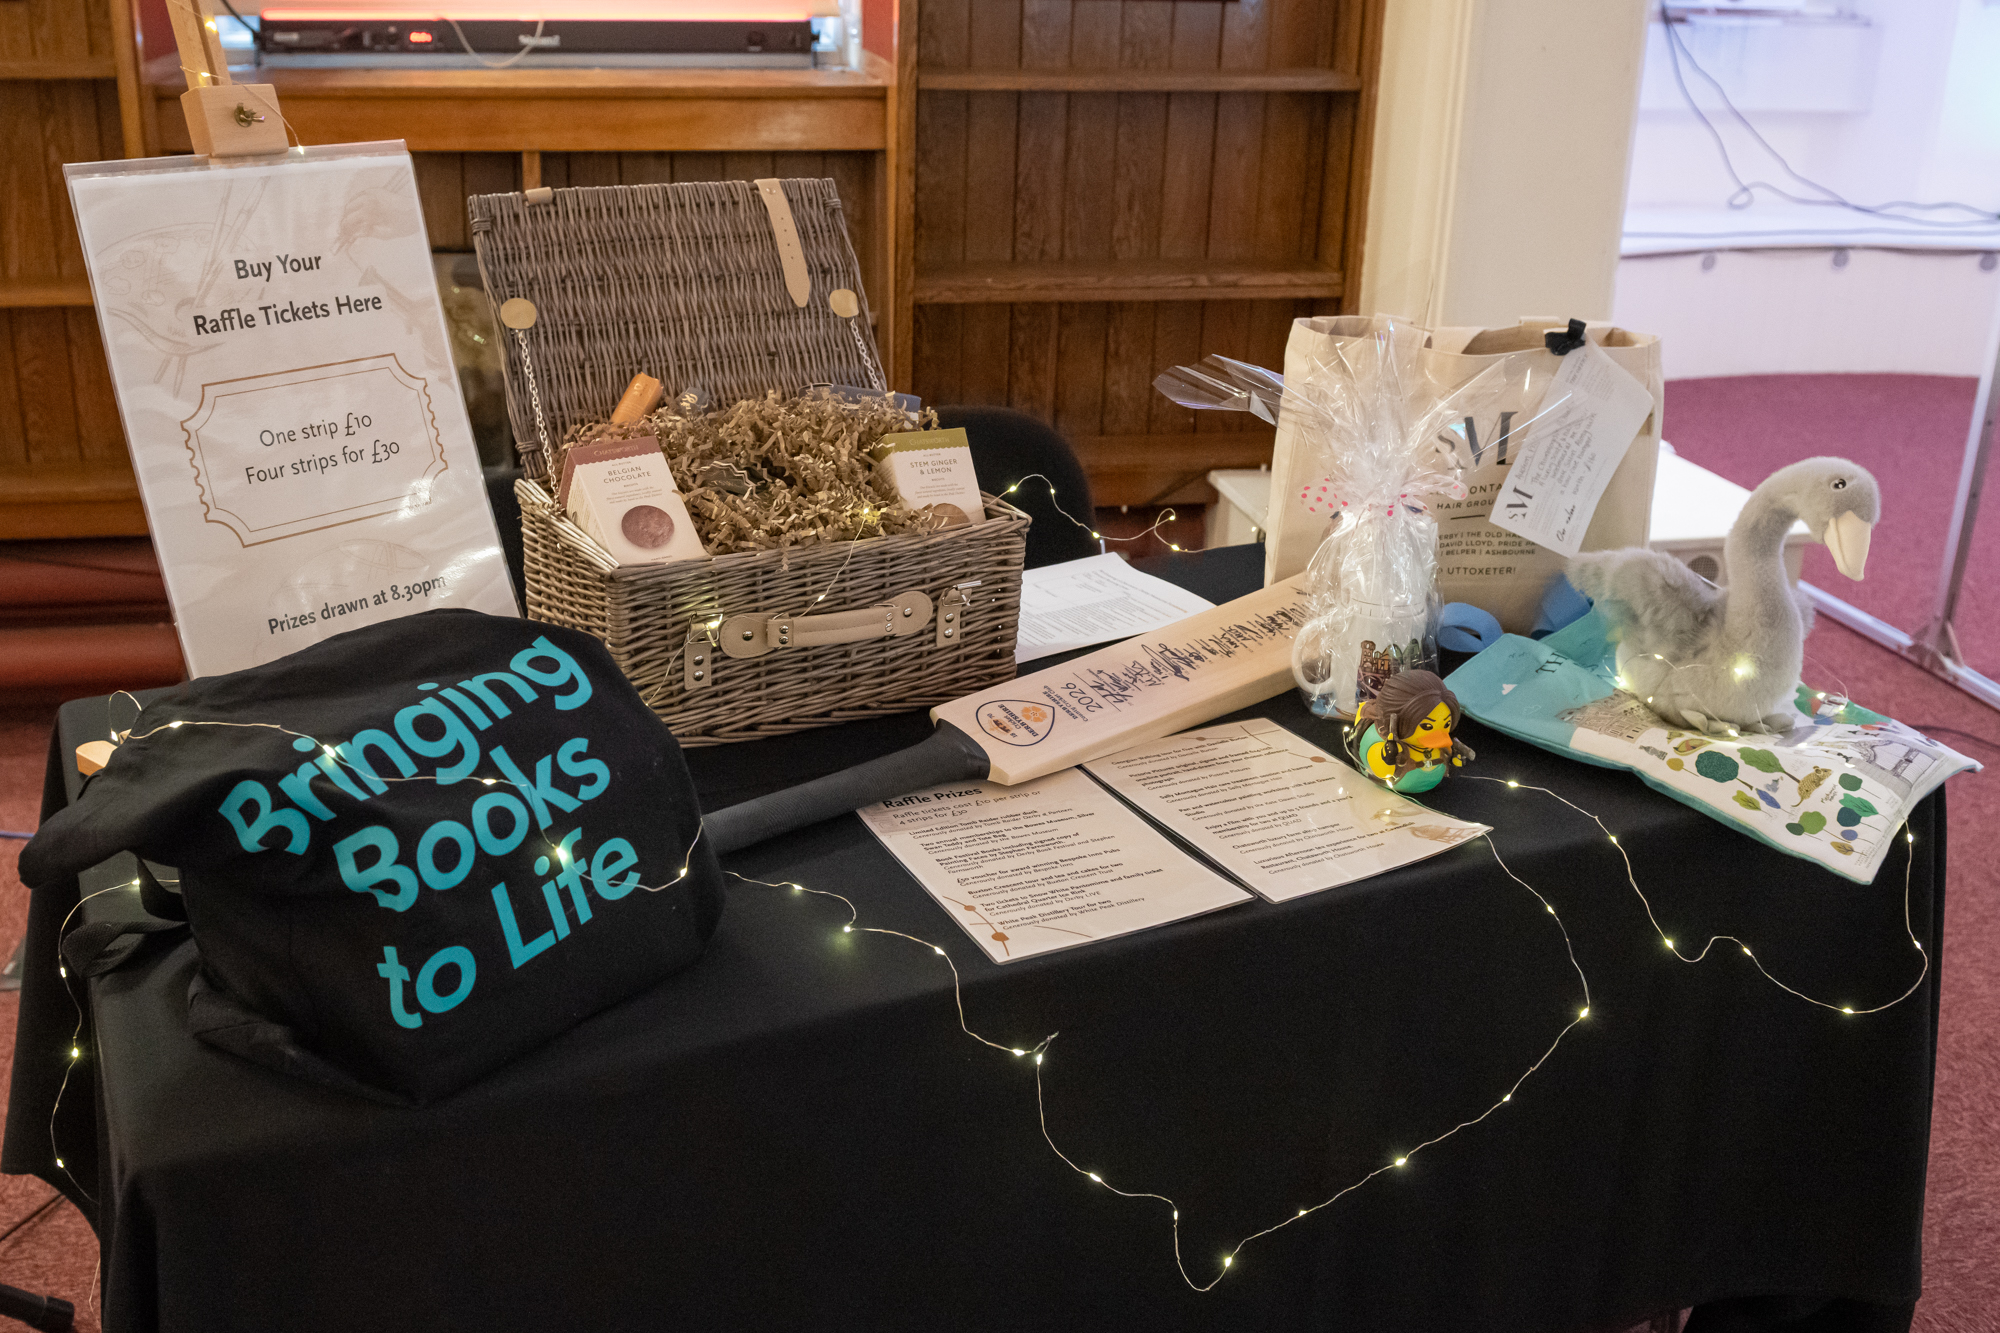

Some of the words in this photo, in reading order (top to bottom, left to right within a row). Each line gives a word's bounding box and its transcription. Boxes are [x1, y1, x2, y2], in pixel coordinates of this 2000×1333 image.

[234, 257, 273, 281] Buy
[276, 254, 322, 274] Your
[193, 308, 256, 335] Raffle
[261, 299, 330, 327] Tickets
[336, 293, 383, 315] Here
[259, 427, 296, 448] One
[301, 418, 339, 442] strip
[344, 413, 372, 436] £10
[246, 464, 285, 485] Four
[291, 453, 338, 479] strips
[342, 446, 365, 465] for
[371, 440, 400, 464] £30
[931, 458, 958, 466] GINGER
[603, 471, 652, 484] CHOCOLATE
[607, 466, 641, 476] BELGIAN
[1437, 502, 1462, 510] HAIR
[1467, 500, 1495, 508] GROU
[1447, 567, 1516, 575] UTTOXETER!
[268, 612, 317, 635] Prizes
[322, 595, 369, 621] drawn
[373, 590, 387, 606] at
[391, 575, 446, 601] 8.30pm
[1043, 684, 1056, 695] Club
[1042, 690, 1079, 720] DERBYSHIRE
[1053, 695, 1072, 709] Cricket
[1060, 682, 1104, 713] 2026
[998, 703, 1039, 737] DERBYSHIRE
[1069, 707, 1089, 722] County
[1003, 715, 1022, 730] Cricket
[218, 635, 593, 855] Bringing
[882, 796, 932, 808] Raffle
[934, 787, 982, 800] Prizes
[921, 806, 951, 814] tickets
[333, 737, 610, 912] Books
[959, 830, 1003, 839] memberships
[993, 881, 1023, 889] Crescent
[1070, 880, 1108, 889] Pantomime
[996, 900, 1029, 909] Cathedral
[1030, 895, 1057, 903] Quarter
[1038, 909, 1069, 917] Distillery
[377, 945, 477, 1029] to
[491, 827, 641, 969] Life
